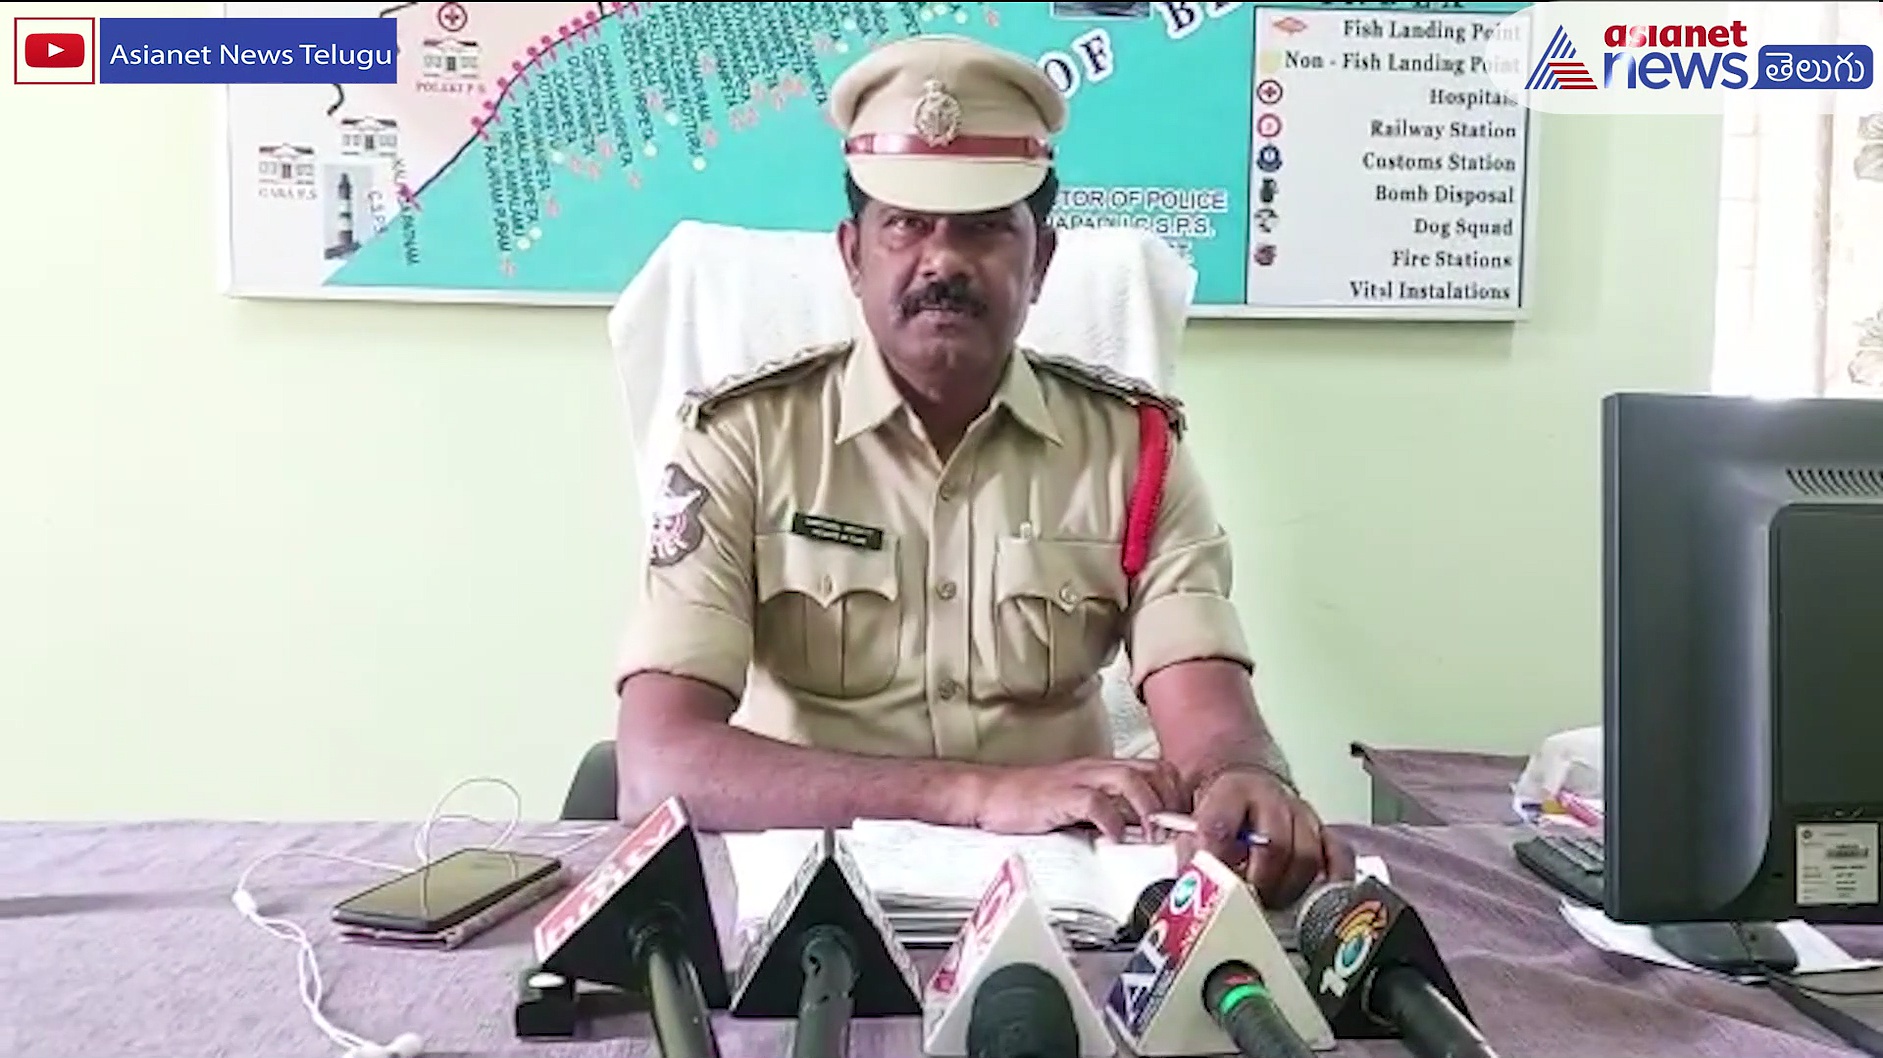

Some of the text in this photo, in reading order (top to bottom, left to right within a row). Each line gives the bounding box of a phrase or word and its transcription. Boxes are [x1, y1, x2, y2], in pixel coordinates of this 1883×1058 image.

[1343, 20, 1383, 37] Fish
[1390, 21, 1465, 43] Landing
[1285, 50, 1324, 68] Non
[1343, 53, 1381, 71] Fish
[1388, 53, 1464, 76] Landing
[1370, 119, 1516, 141] Railway Station
[1362, 152, 1516, 171] Customs Station
[1111, 190, 1142, 207] OF
[1148, 190, 1225, 209] POLICE
[1375, 184, 1514, 206] Bomb Disposal
[1414, 218, 1513, 239] Dog Squad
[1392, 250, 1511, 268] Fire Stations
[1400, 281, 1510, 300] Instalations
